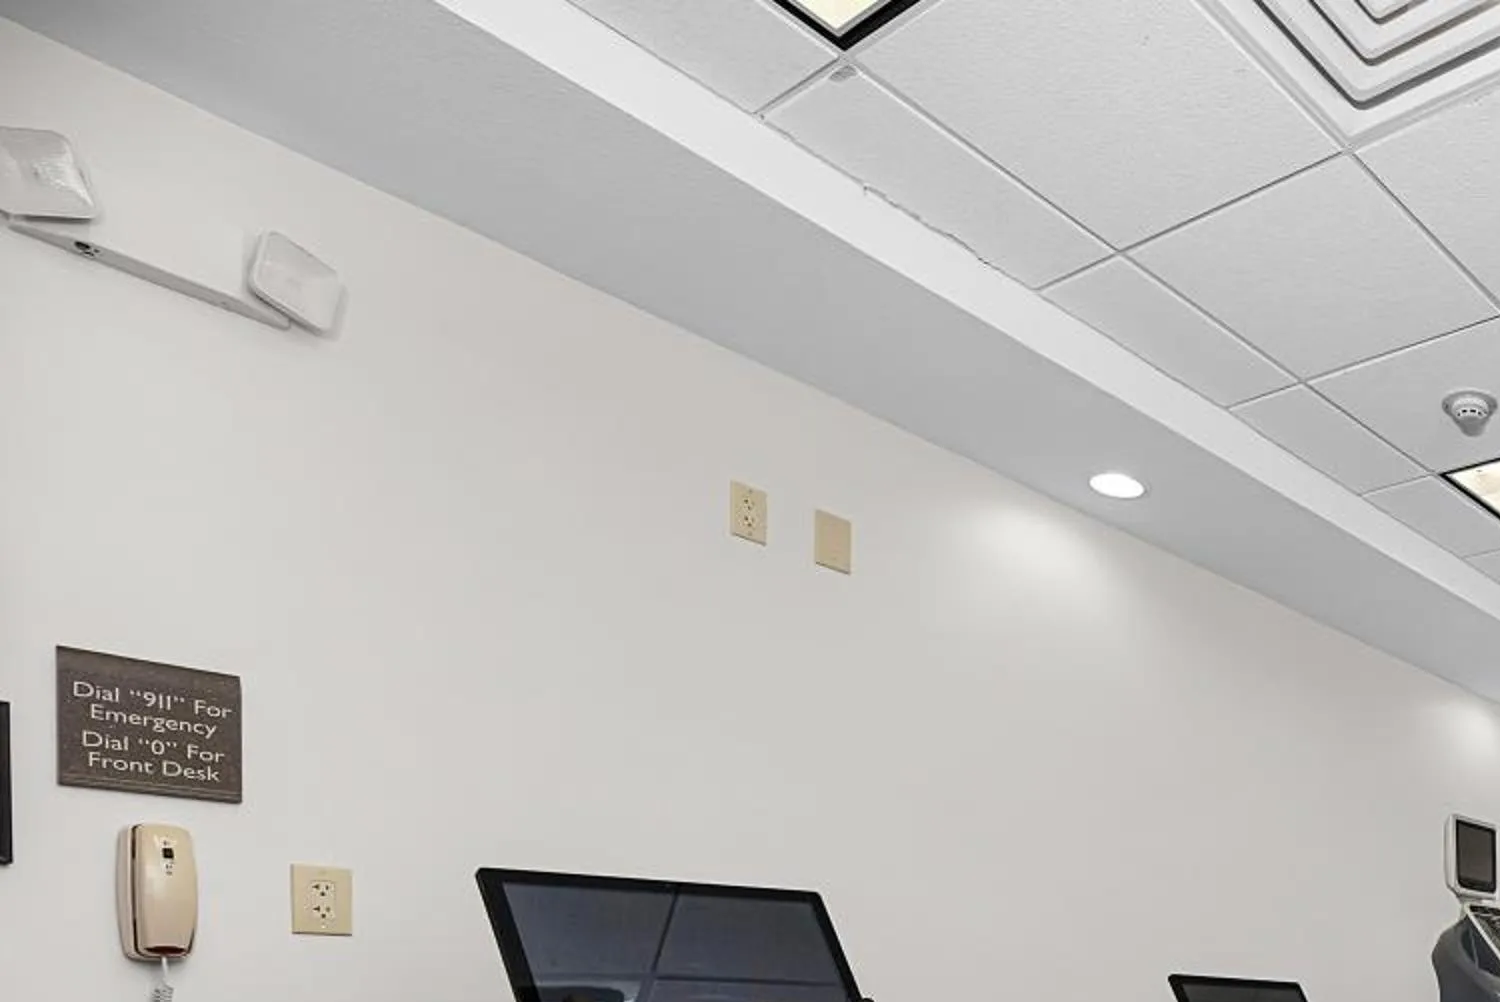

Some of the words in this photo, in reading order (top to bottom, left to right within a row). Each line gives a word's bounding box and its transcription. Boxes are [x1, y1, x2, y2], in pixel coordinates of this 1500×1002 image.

[73, 681, 119, 702] Dial
[129, 688, 185, 711] "911"
[194, 700, 232, 718] For
[90, 703, 217, 739] Emergency
[82, 730, 129, 751] Dial
[187, 744, 225, 763] For
[88, 752, 153, 774] Front
[162, 761, 220, 782] Desk
